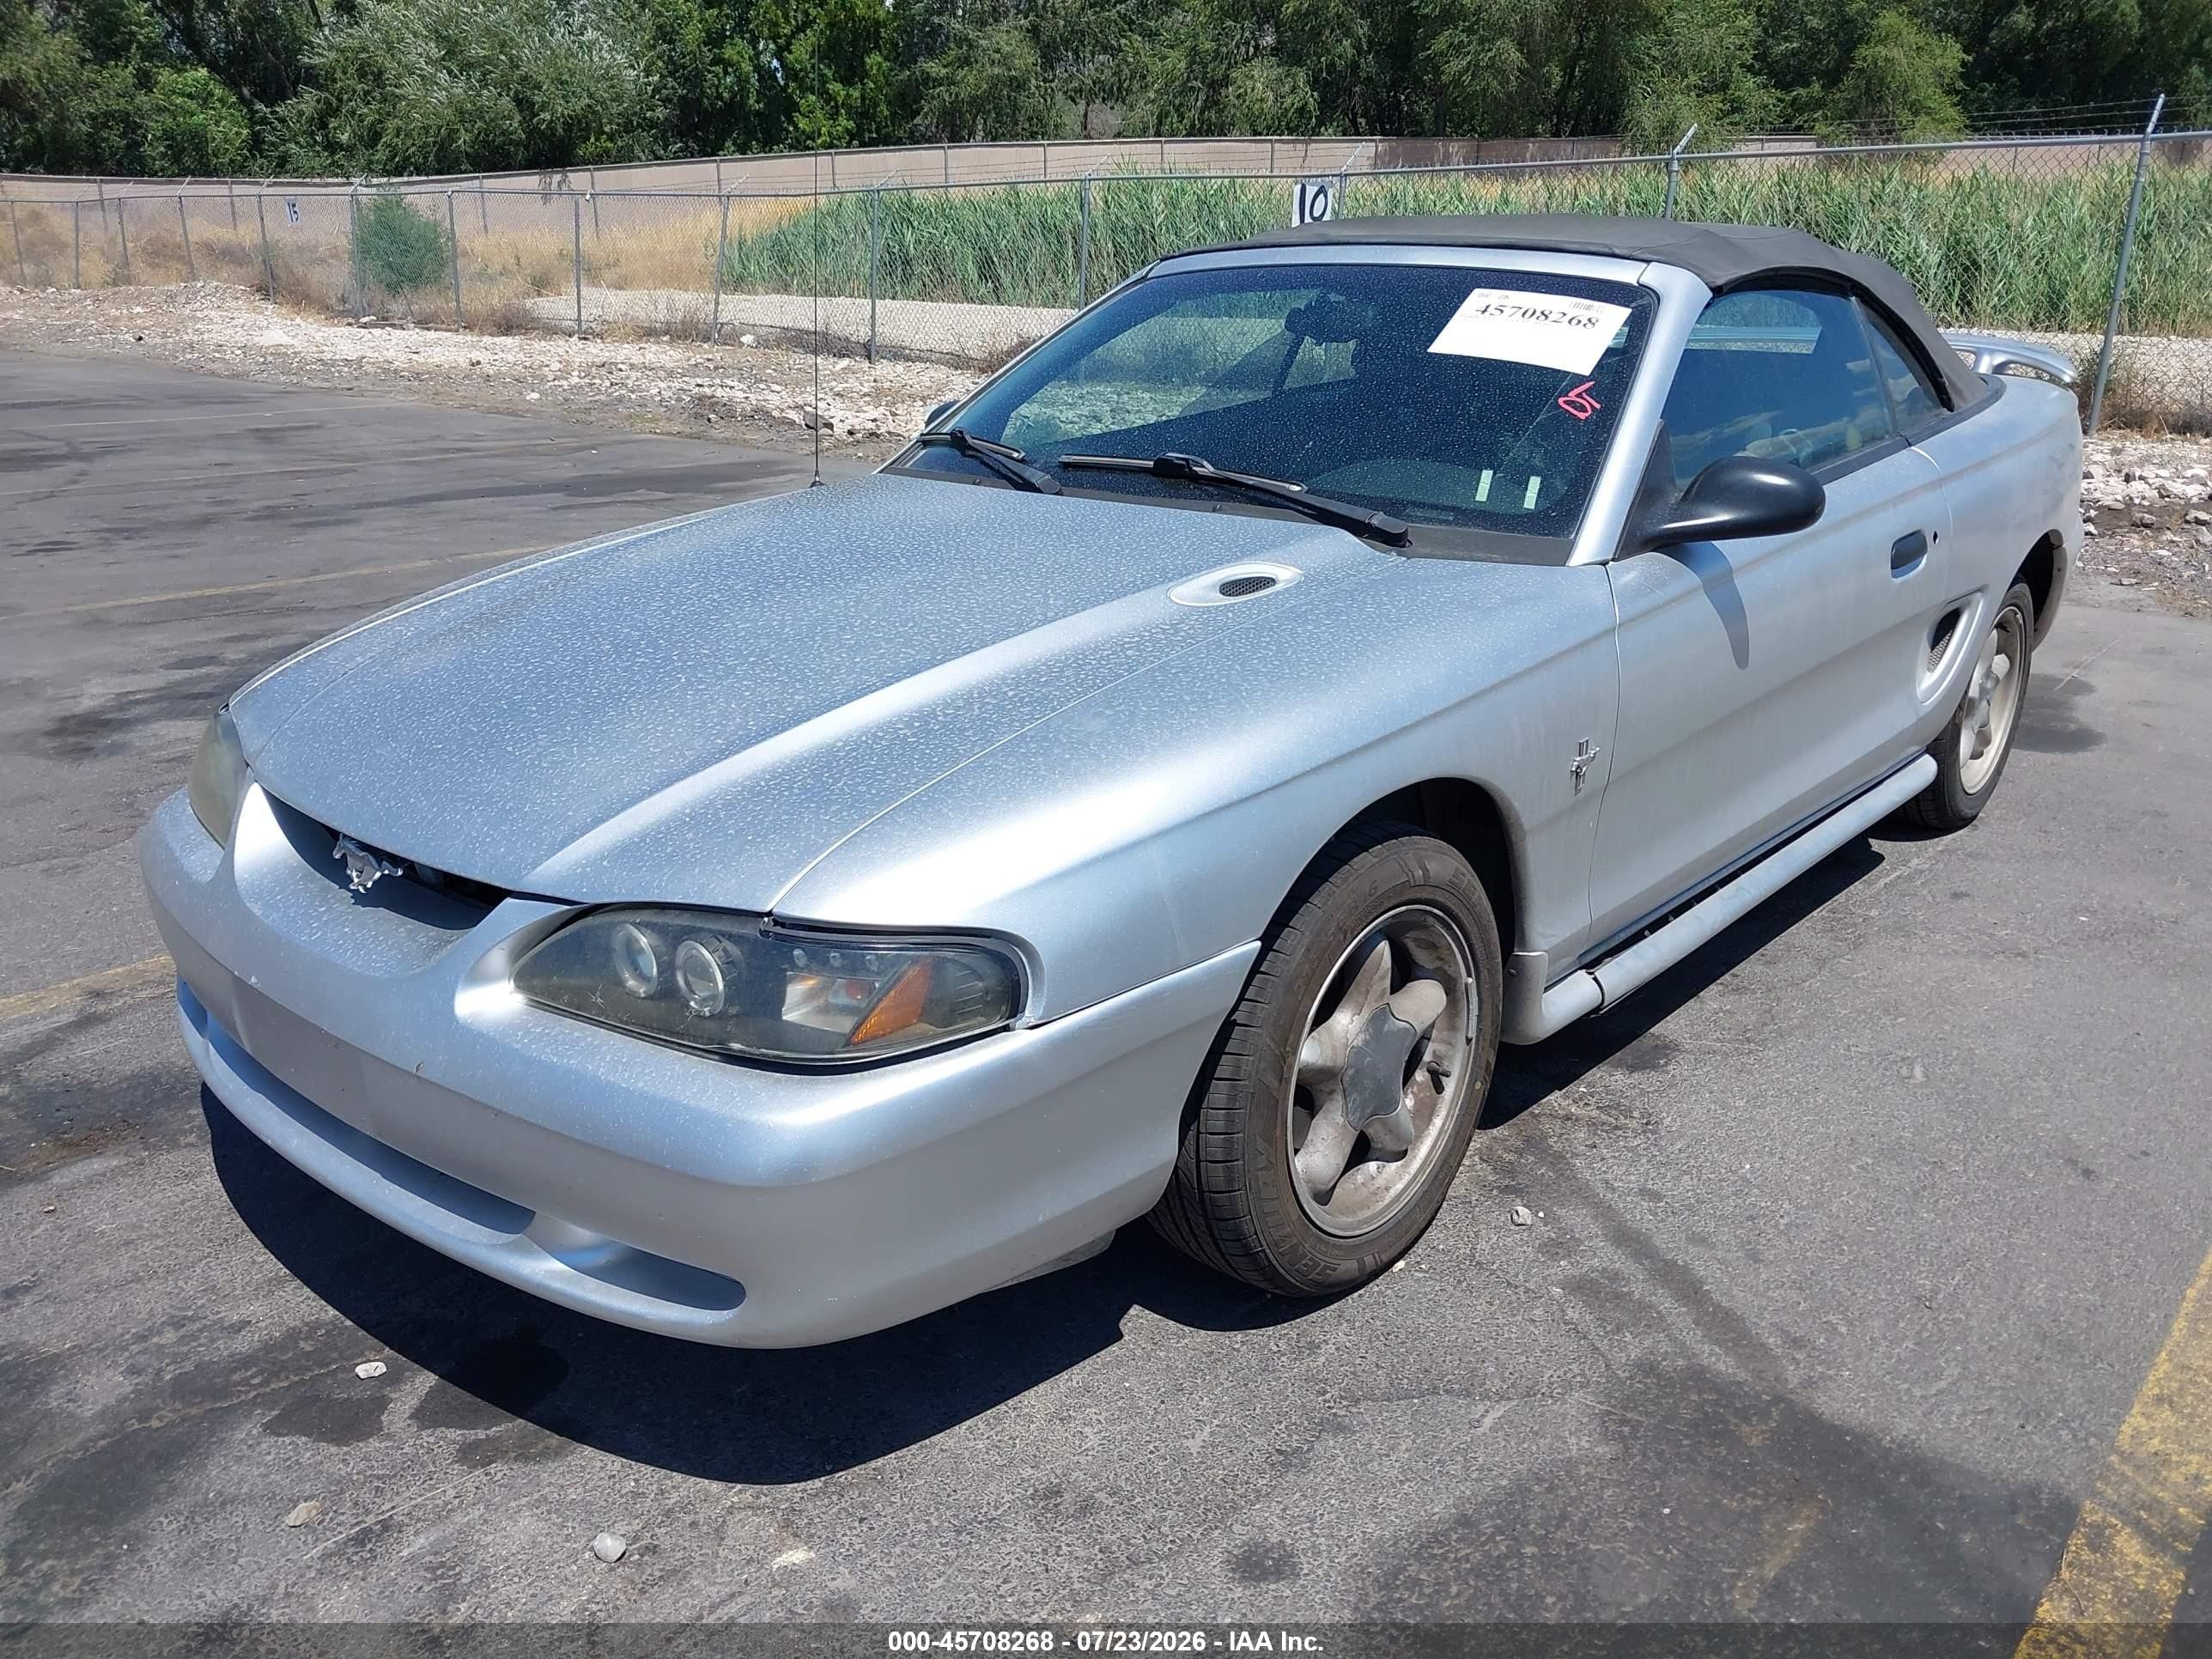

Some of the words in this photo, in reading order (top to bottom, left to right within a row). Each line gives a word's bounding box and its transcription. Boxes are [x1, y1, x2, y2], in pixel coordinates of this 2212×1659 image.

[288, 202, 299, 222] 15
[1299, 183, 1328, 224] 10
[1475, 303, 1599, 330] 45708268
